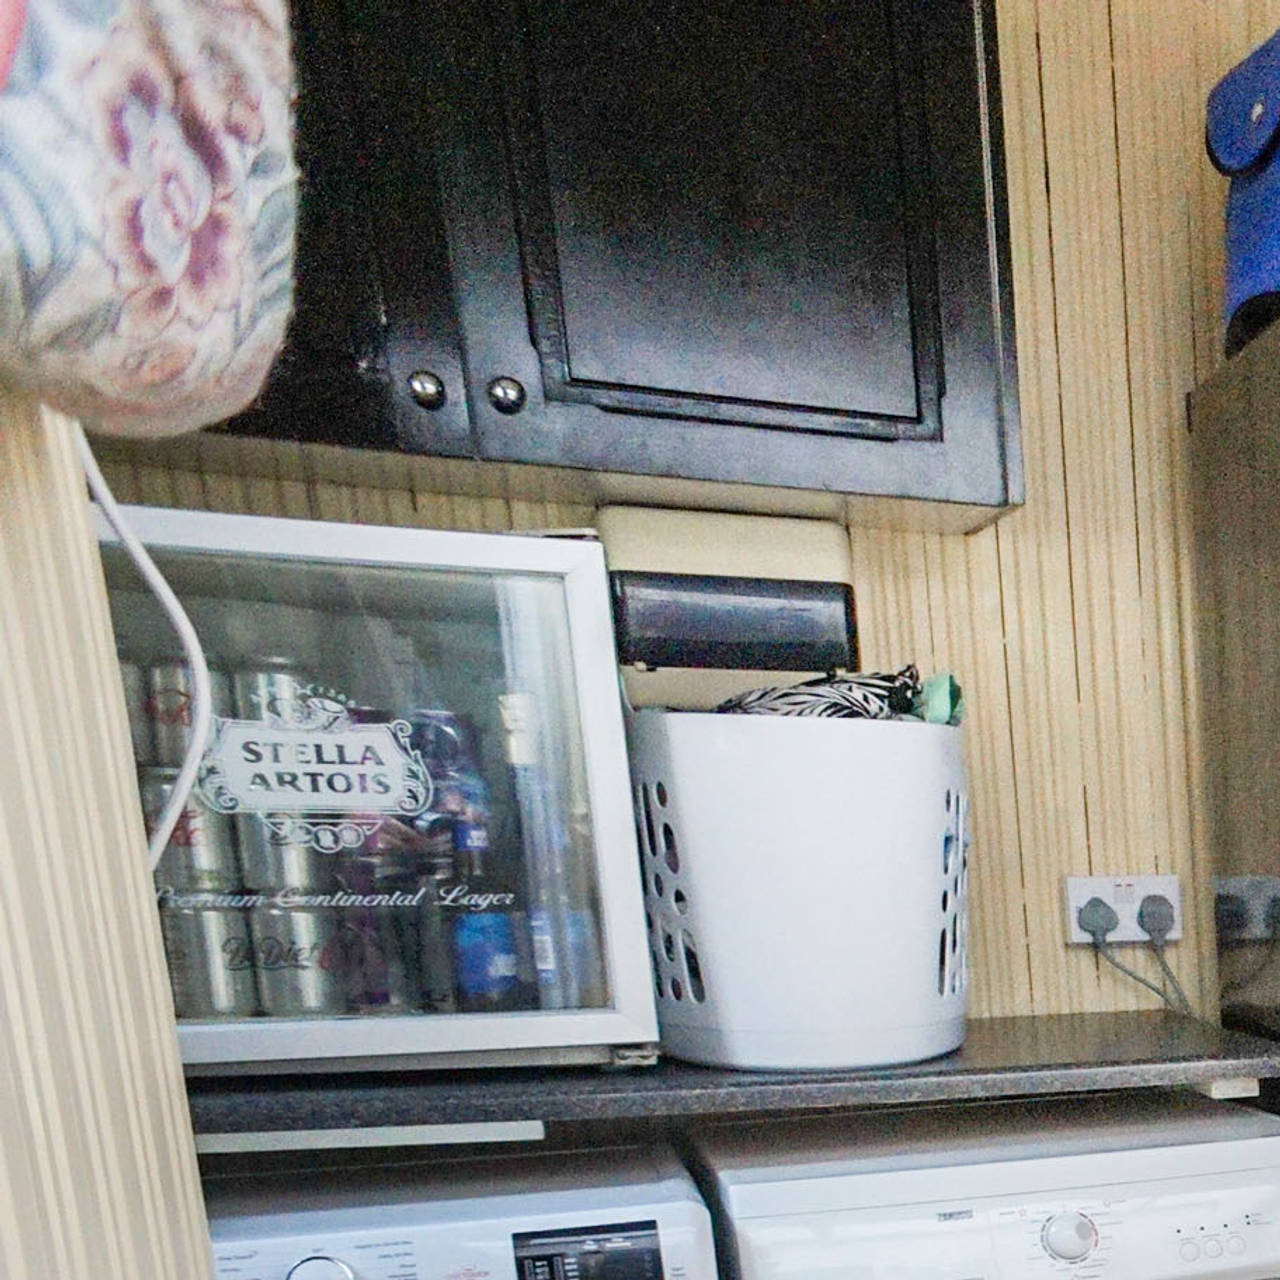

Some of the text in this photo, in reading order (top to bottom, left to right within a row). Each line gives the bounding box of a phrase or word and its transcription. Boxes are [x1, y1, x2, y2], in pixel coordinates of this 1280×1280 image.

[242, 740, 385, 766] STELLA
[249, 771, 392, 795] ARTOIS
[274, 885, 426, 909] Continental
[438, 884, 517, 912] Lager
